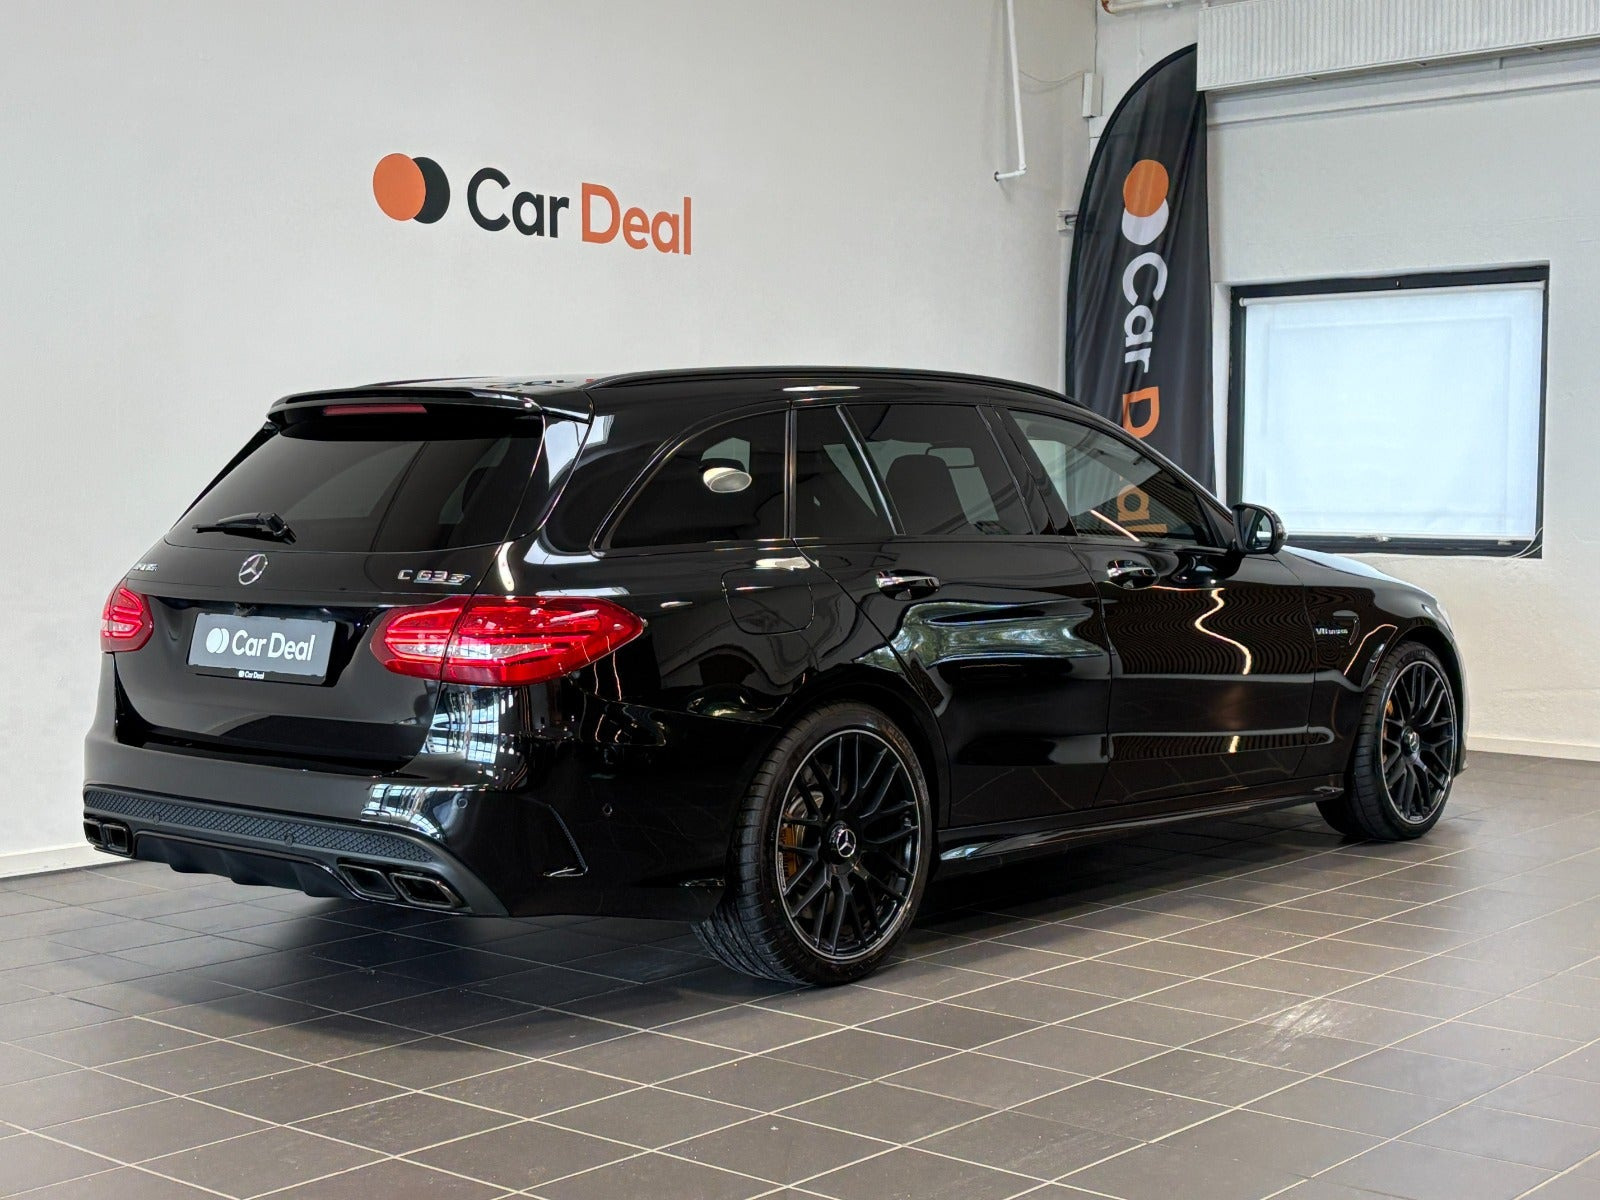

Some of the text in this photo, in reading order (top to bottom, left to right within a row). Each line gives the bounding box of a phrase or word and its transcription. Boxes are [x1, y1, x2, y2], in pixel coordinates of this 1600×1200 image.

[467, 167, 692, 255] Car Deal
[1122, 251, 1168, 373] Car
[397, 569, 413, 580] C
[232, 629, 316, 661] Car Deal
